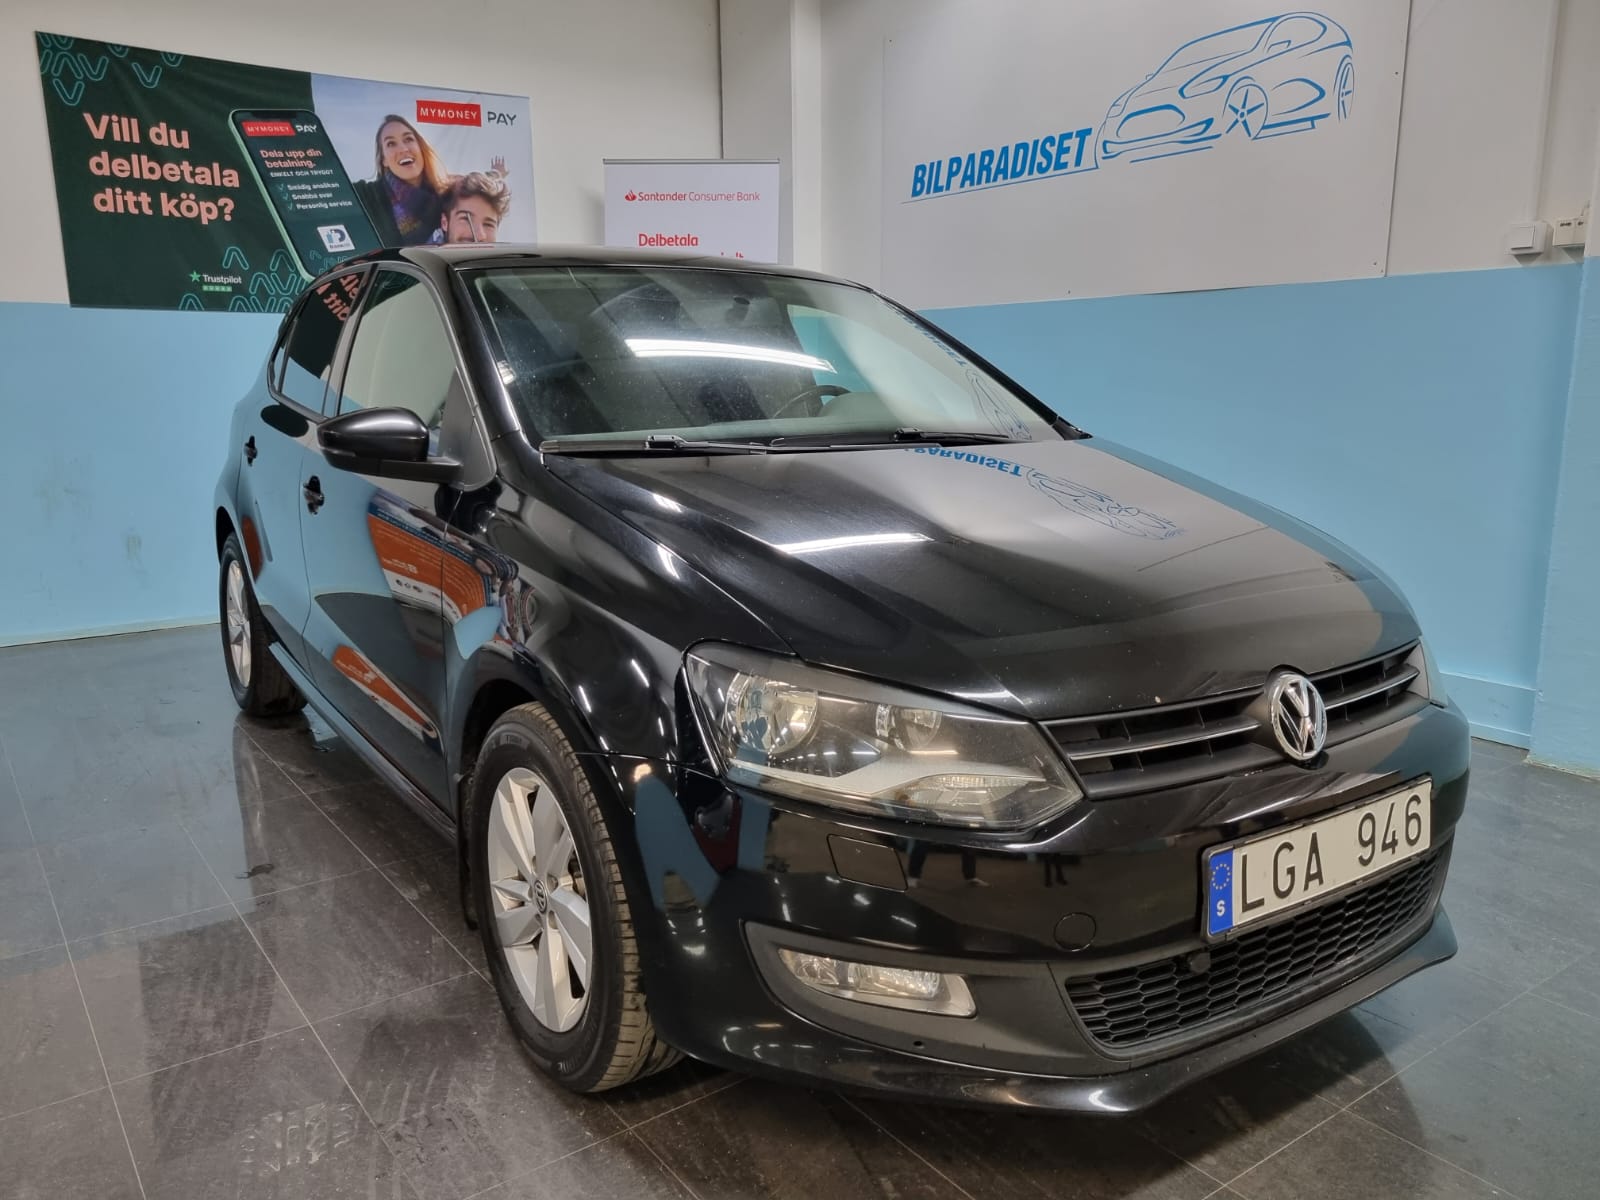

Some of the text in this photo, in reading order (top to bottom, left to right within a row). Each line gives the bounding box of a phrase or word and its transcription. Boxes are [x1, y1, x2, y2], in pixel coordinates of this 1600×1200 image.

[420, 107, 517, 126] MYMONEY PAY
[83, 112, 190, 149] Vill du
[295, 125, 317, 133] PAY
[260, 149, 323, 160] Dela upp din
[911, 127, 1093, 198] BILPARADISET
[88, 151, 239, 187] delbetala
[265, 159, 316, 169] betalning.
[638, 191, 760, 201] Santander Consumer Bank
[93, 188, 235, 225] ditt köp?
[638, 233, 699, 247] Delbetala
[202, 273, 242, 284] Trustpilot
[1240, 793, 1423, 913] LGA 946
[1216, 899, 1226, 917] S
